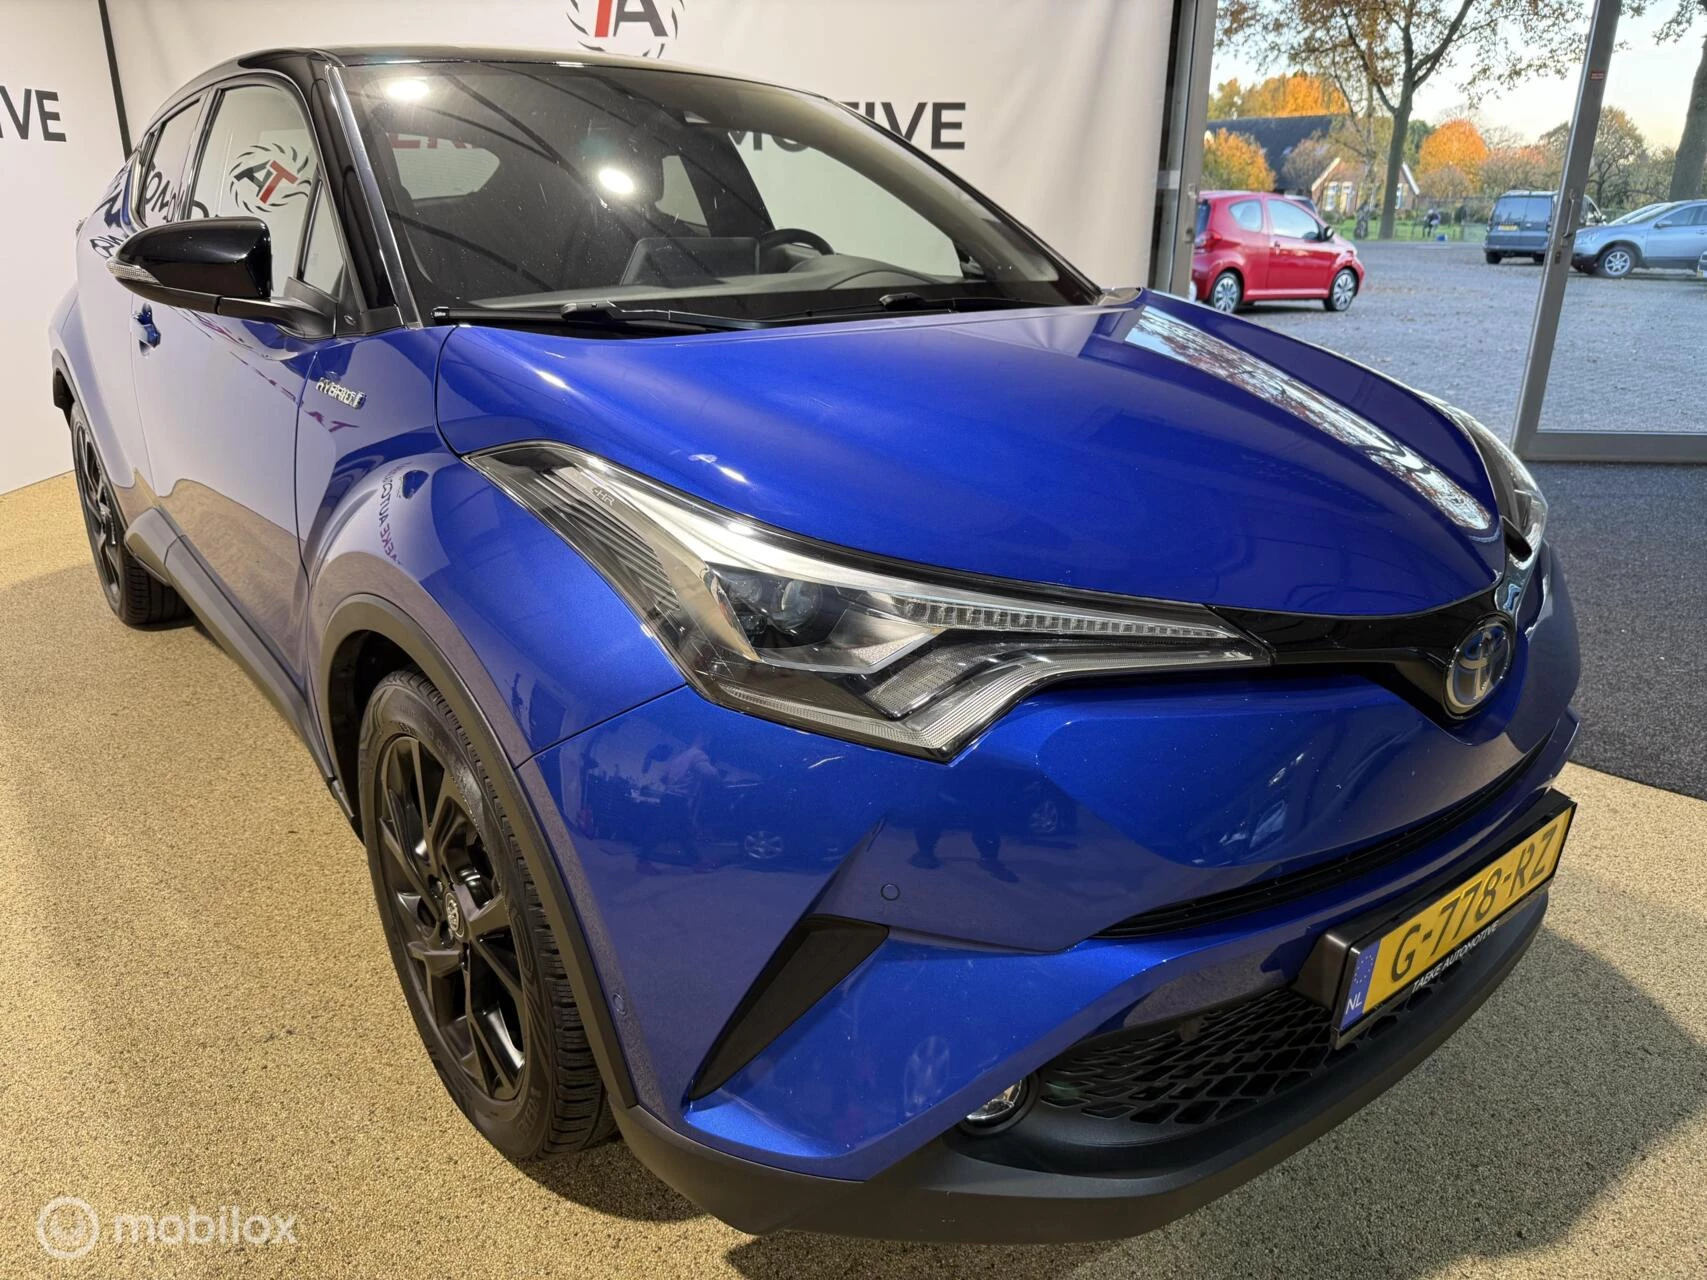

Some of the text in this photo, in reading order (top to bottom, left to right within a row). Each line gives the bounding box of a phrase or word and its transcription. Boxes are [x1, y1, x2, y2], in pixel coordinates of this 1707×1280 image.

[1390, 824, 1558, 983] G-778-RZ
[1441, 918, 1500, 972] AUTOMOTIVE
[1345, 991, 1363, 1016] NL
